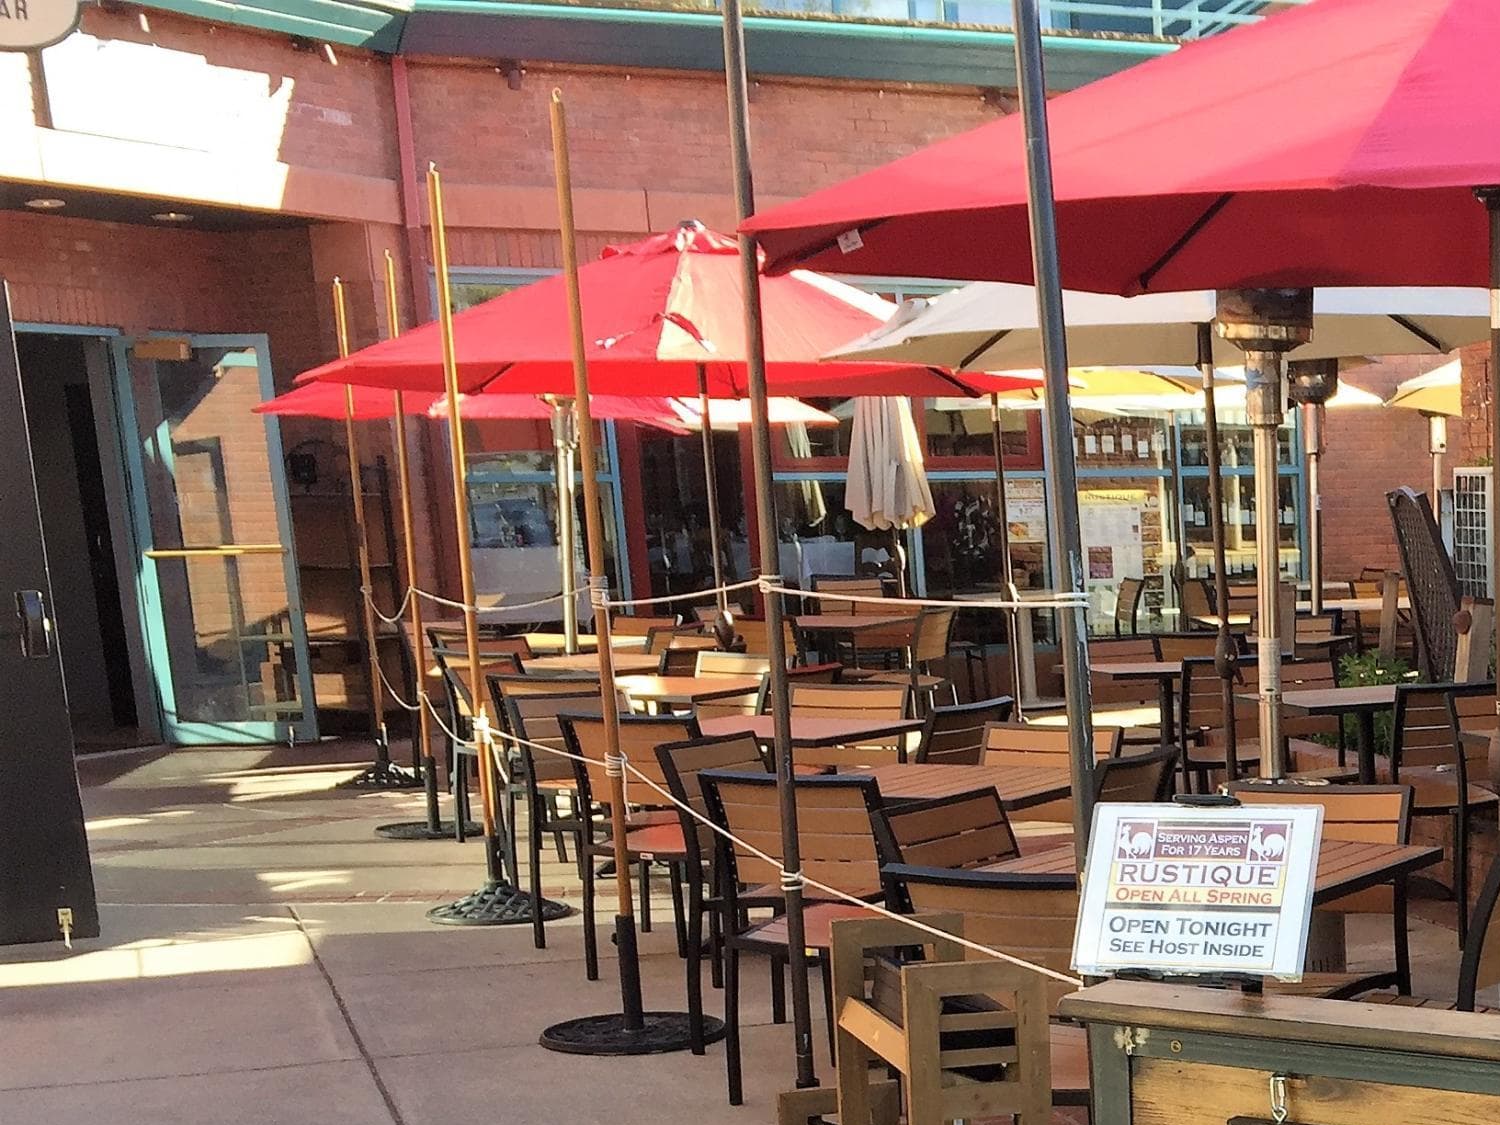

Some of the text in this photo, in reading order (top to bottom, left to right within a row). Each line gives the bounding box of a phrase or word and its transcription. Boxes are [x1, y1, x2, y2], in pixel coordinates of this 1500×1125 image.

[1158, 833, 1247, 844] SERVING ASPEN
[1161, 845, 1240, 856] FOR 17 YEARS
[1119, 864, 1276, 887] RUSTIQUE
[1116, 887, 1272, 904] OPEN ALL SPRING
[1109, 916, 1272, 937] OPEN TONIGHT
[1110, 938, 1264, 957] SEE HOST INSIDE
